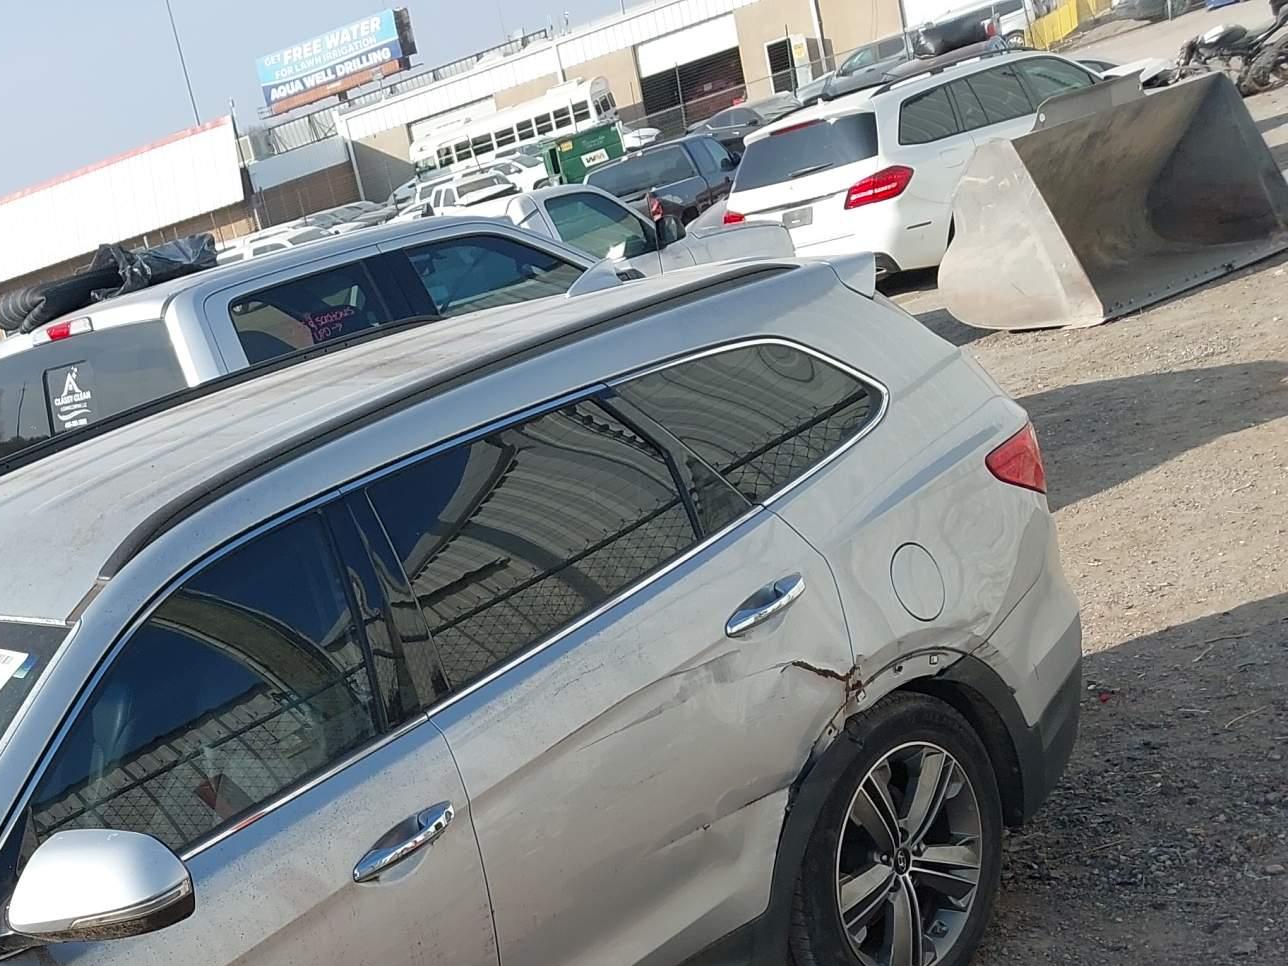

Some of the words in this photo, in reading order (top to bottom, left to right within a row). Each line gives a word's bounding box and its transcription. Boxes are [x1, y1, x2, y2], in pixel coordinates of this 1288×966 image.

[275, 67, 294, 80] FOR
[295, 57, 322, 73] LAWN
[322, 34, 377, 63] IRRIGATION
[283, 38, 323, 65] FREE
[326, 16, 381, 49] WATER
[270, 80, 303, 101] AQUA
[303, 68, 336, 89] WELL
[335, 47, 392, 77] DRILLING
